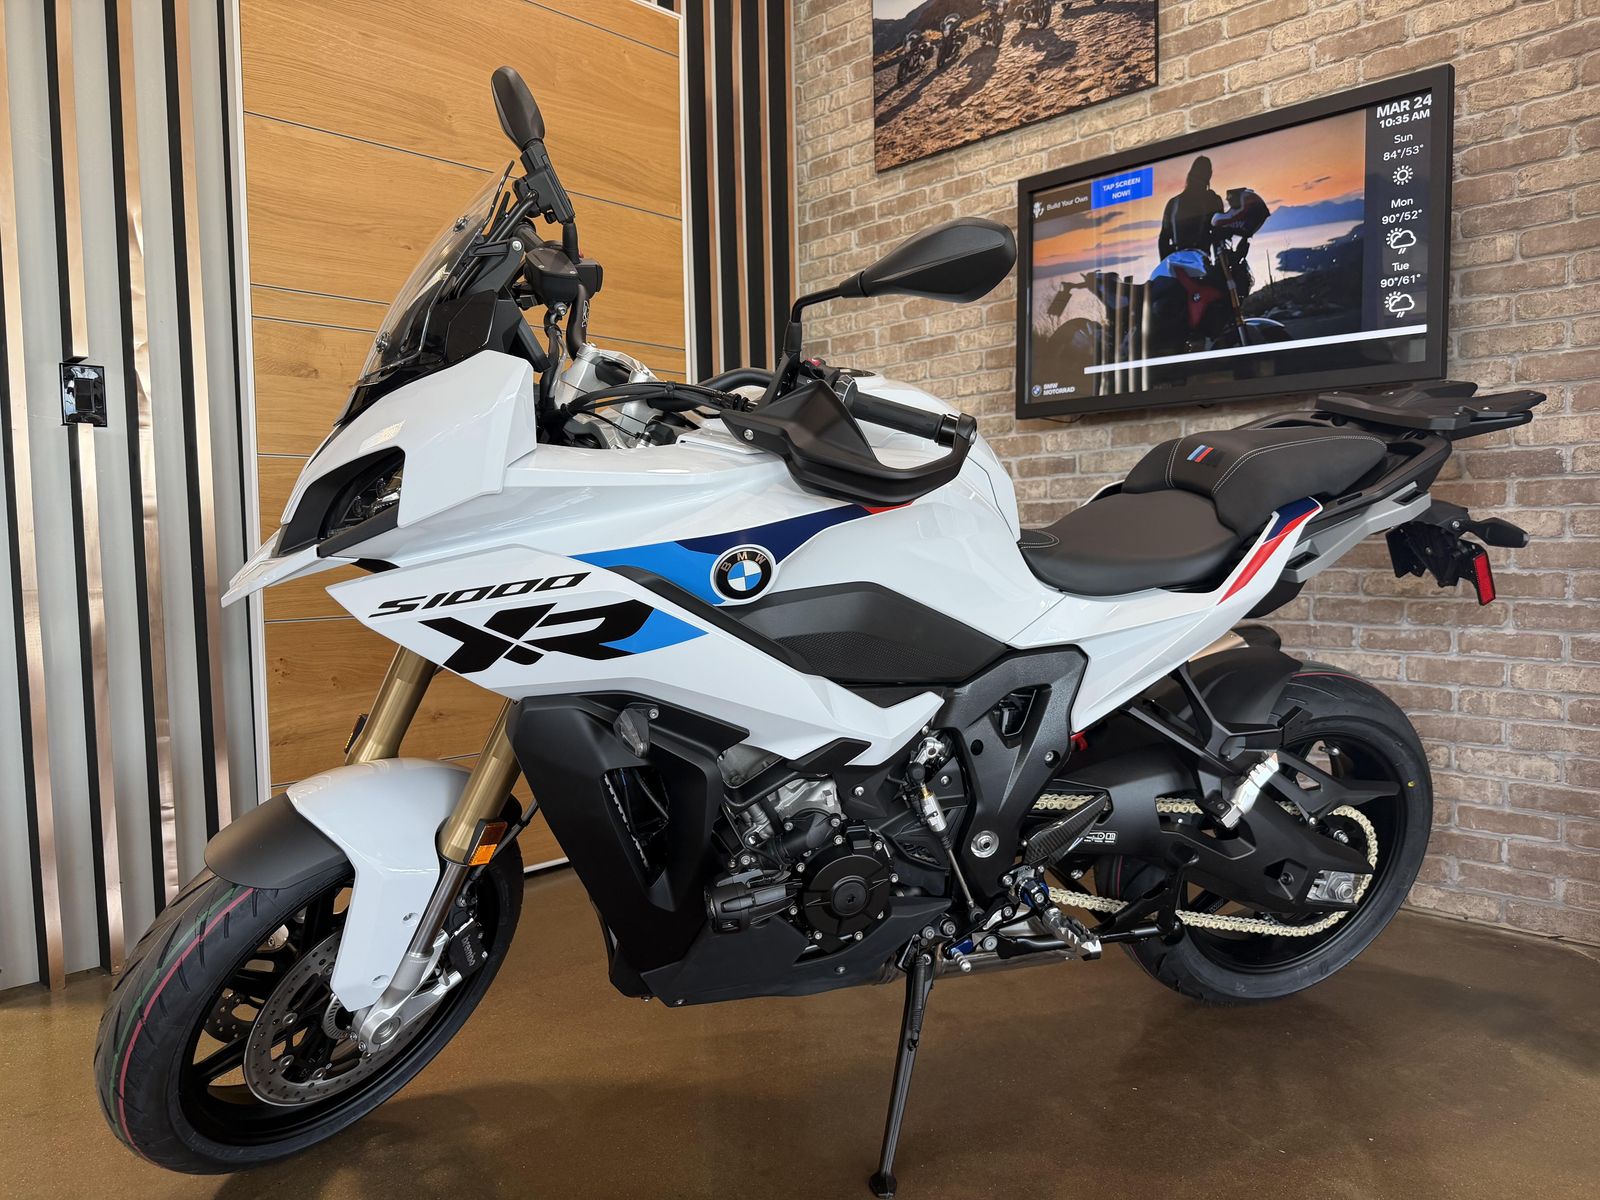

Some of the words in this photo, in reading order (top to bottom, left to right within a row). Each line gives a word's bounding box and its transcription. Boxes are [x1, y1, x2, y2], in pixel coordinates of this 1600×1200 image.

[1376, 100, 1410, 118] MAR
[1413, 94, 1432, 109] 24
[1379, 113, 1410, 128] 10:35
[1411, 108, 1430, 121] AM
[1393, 133, 1413, 144] Sun
[1383, 143, 1424, 161] 84°/53°
[1102, 183, 1115, 192] TAP
[1115, 177, 1141, 189] SCREEN
[1112, 190, 1131, 199] NOW!
[1046, 202, 1061, 211] Build
[1074, 195, 1088, 203] Own
[1391, 198, 1414, 209] Mon
[1381, 209, 1423, 225] 90°/52°
[1391, 262, 1410, 272] Tue
[1380, 273, 1421, 288] 90°/61°
[1043, 386, 1076, 396] MOTORRAD
[720, 551, 767, 572] BMW
[417, 598, 656, 674] XR
[461, 934, 476, 967] brembo
